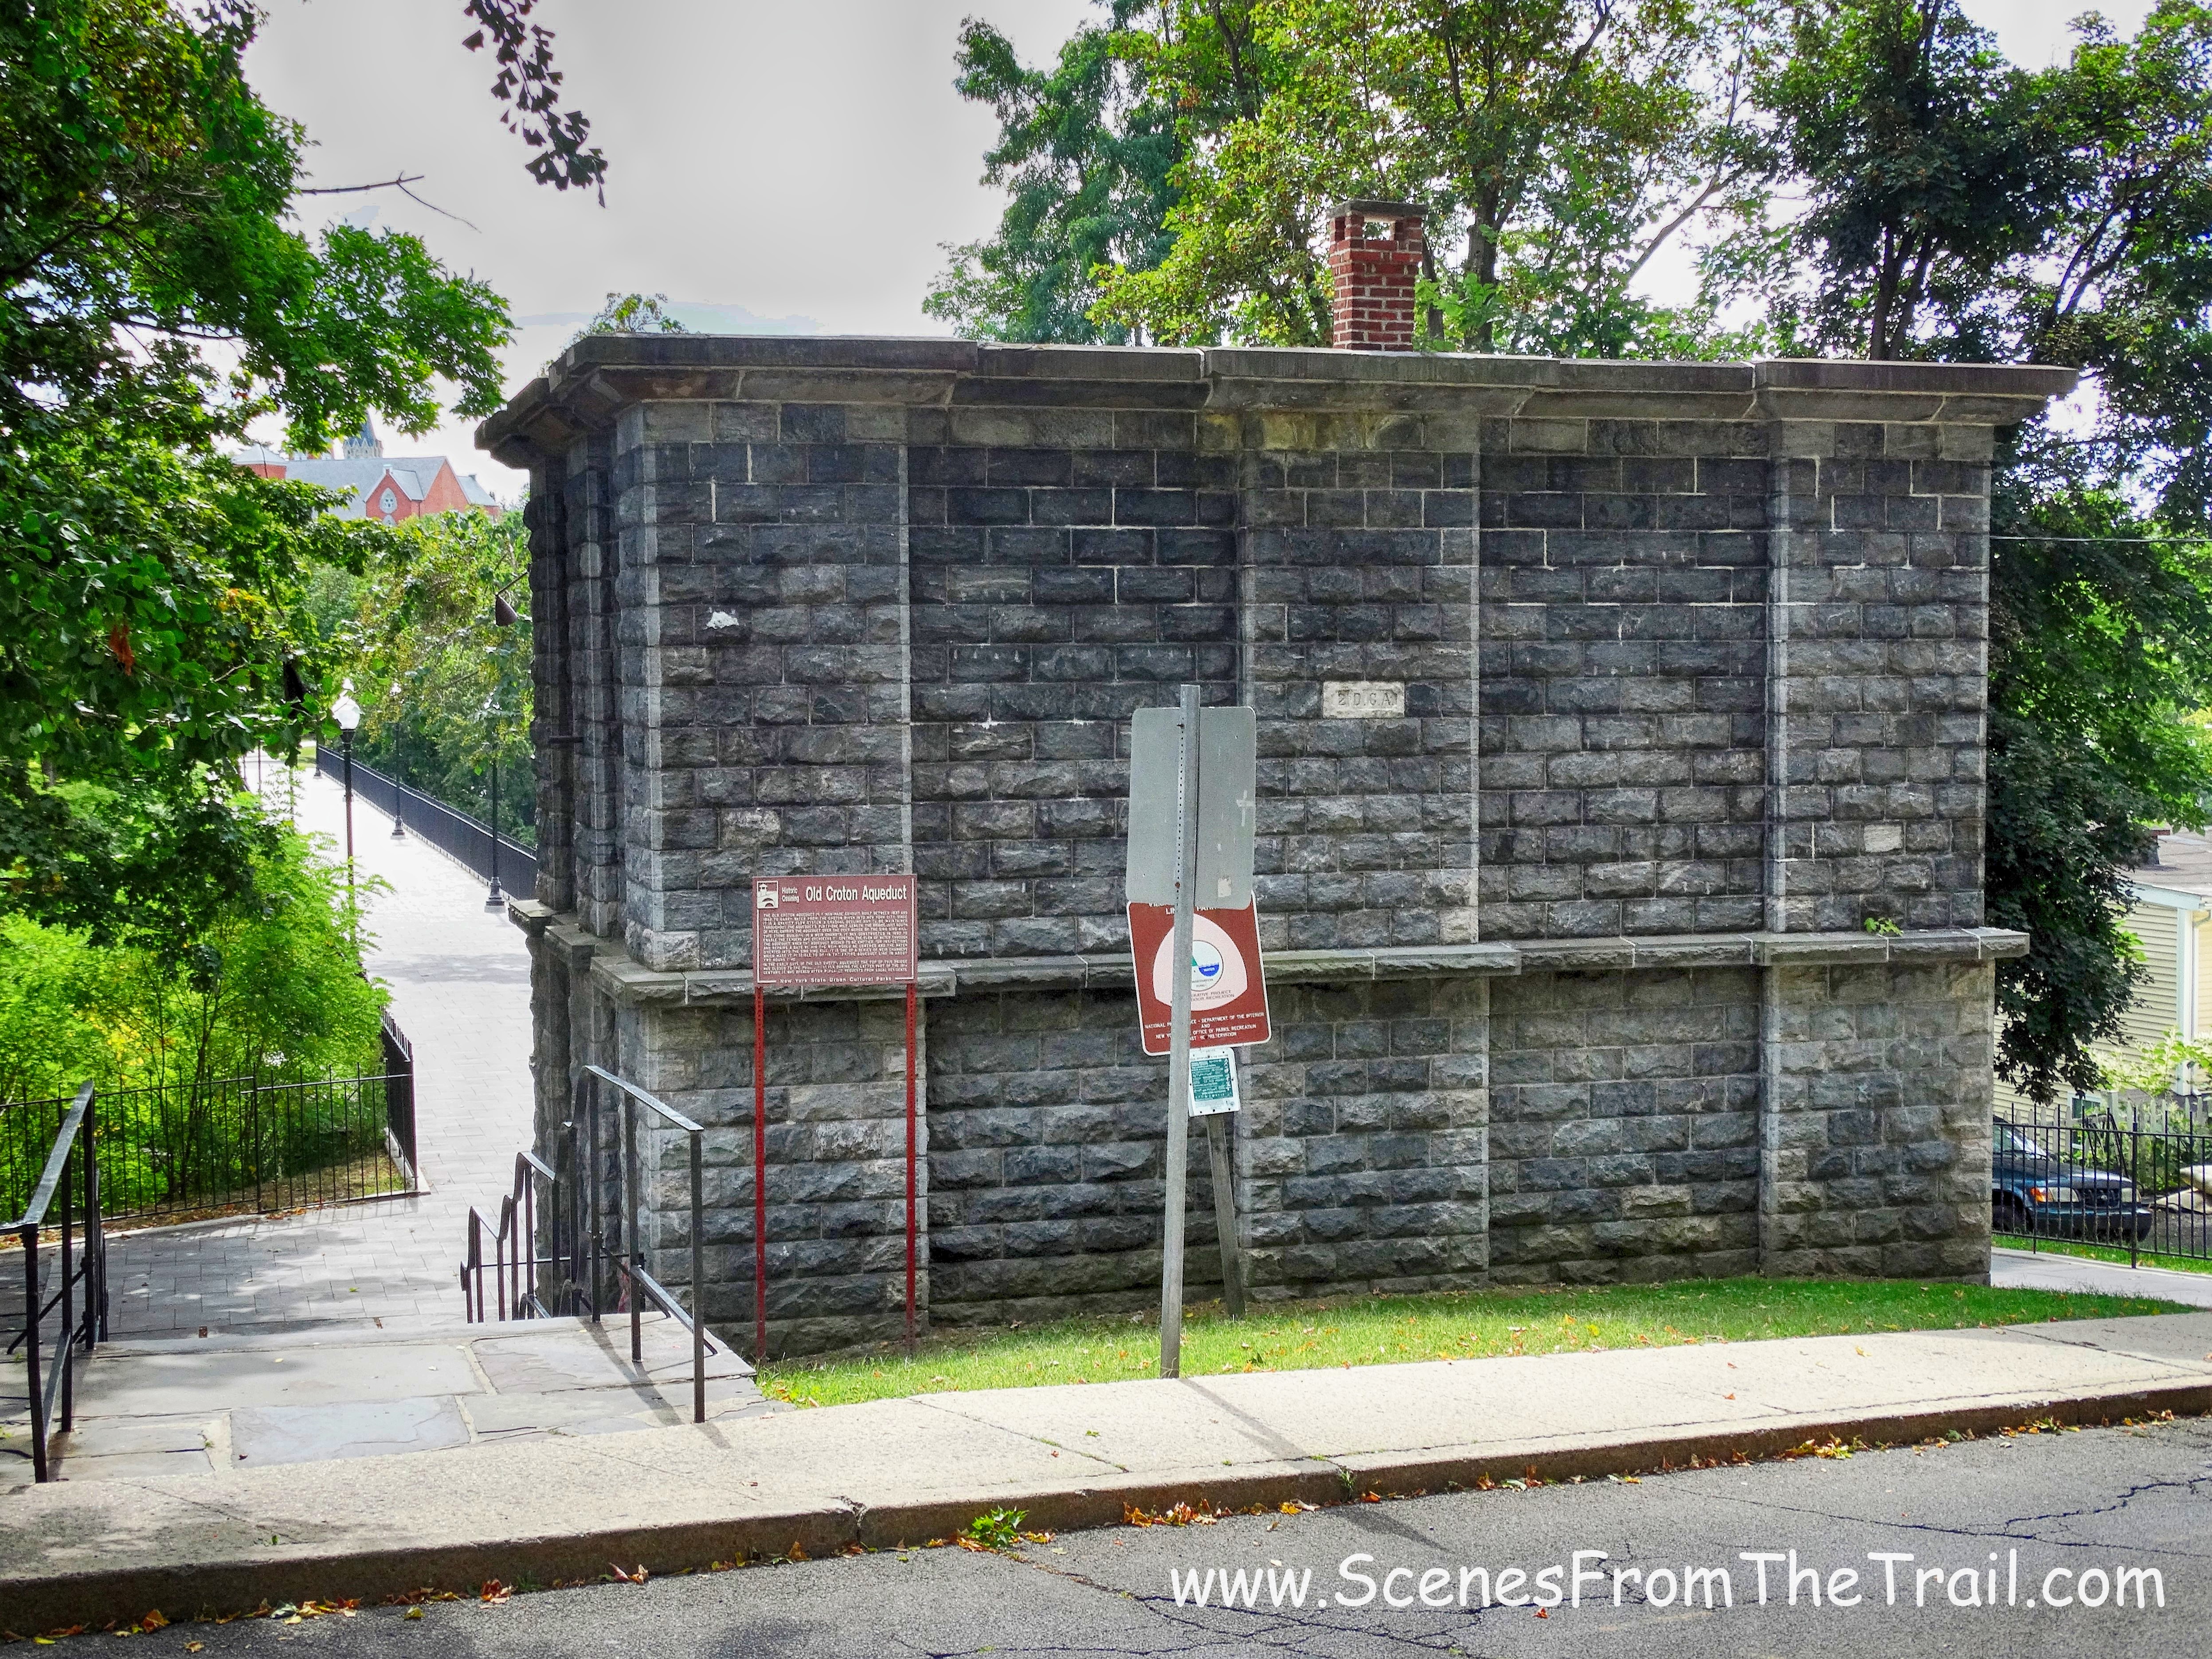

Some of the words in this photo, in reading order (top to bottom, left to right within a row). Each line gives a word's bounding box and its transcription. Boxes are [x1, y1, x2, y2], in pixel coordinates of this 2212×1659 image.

[806, 886, 822, 902] Old
[826, 885, 858, 901] Croton
[861, 885, 907, 904] Aqueduct
